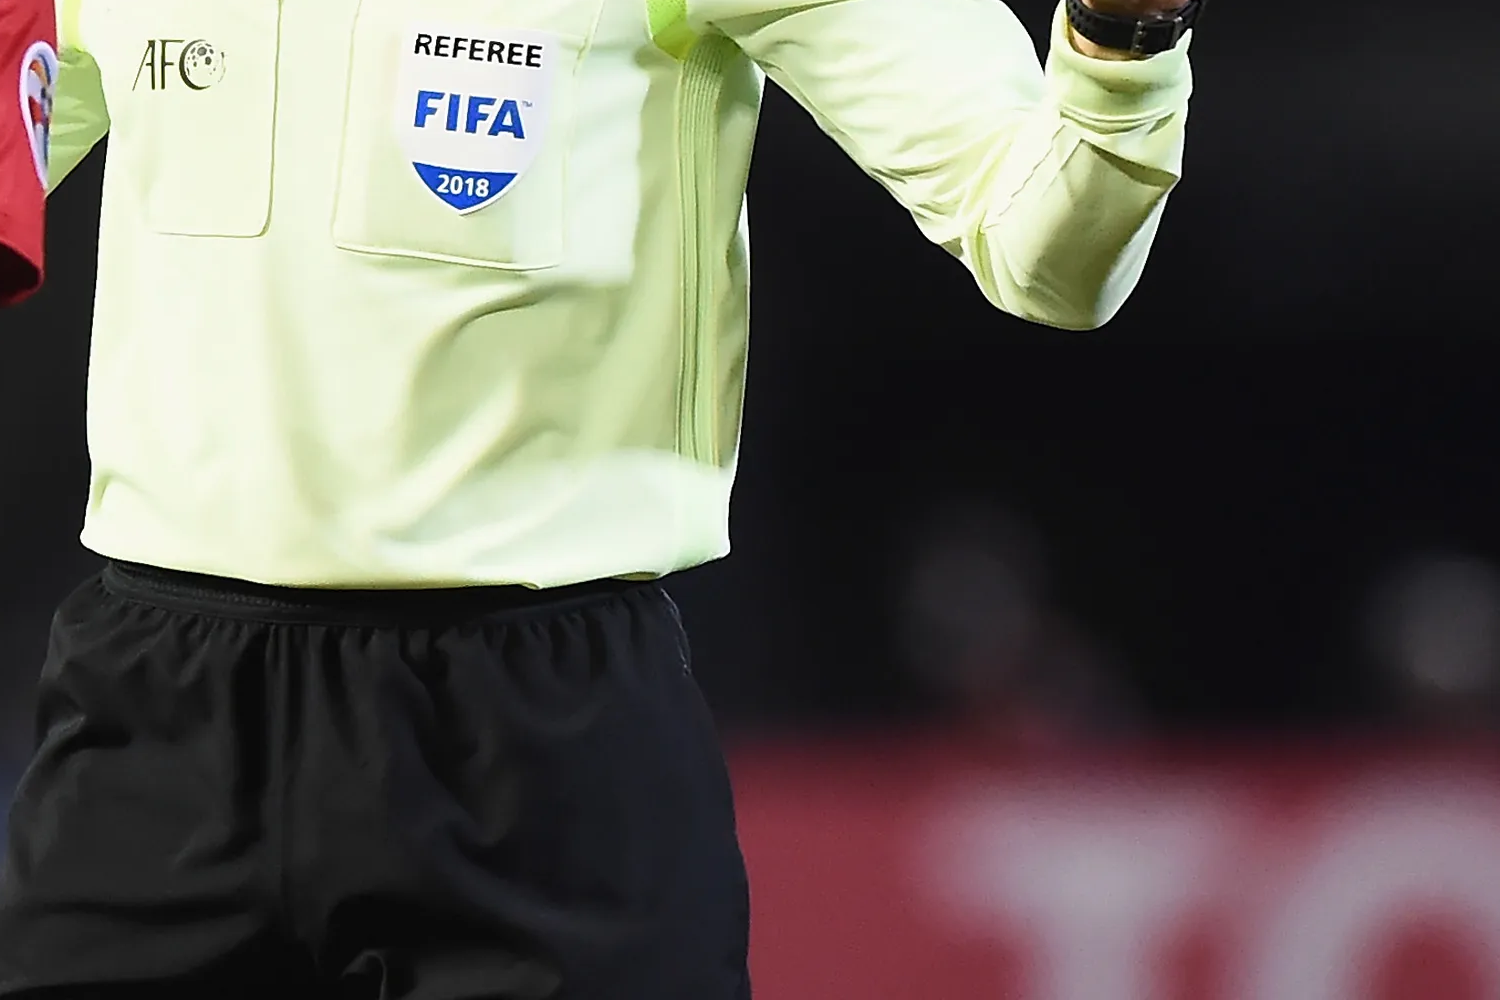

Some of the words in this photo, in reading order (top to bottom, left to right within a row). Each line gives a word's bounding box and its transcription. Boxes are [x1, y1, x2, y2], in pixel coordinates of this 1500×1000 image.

[132, 39, 226, 91] AFC
[414, 33, 543, 68] REFEREE
[414, 90, 525, 139] FIFA
[436, 174, 490, 197] 2018
